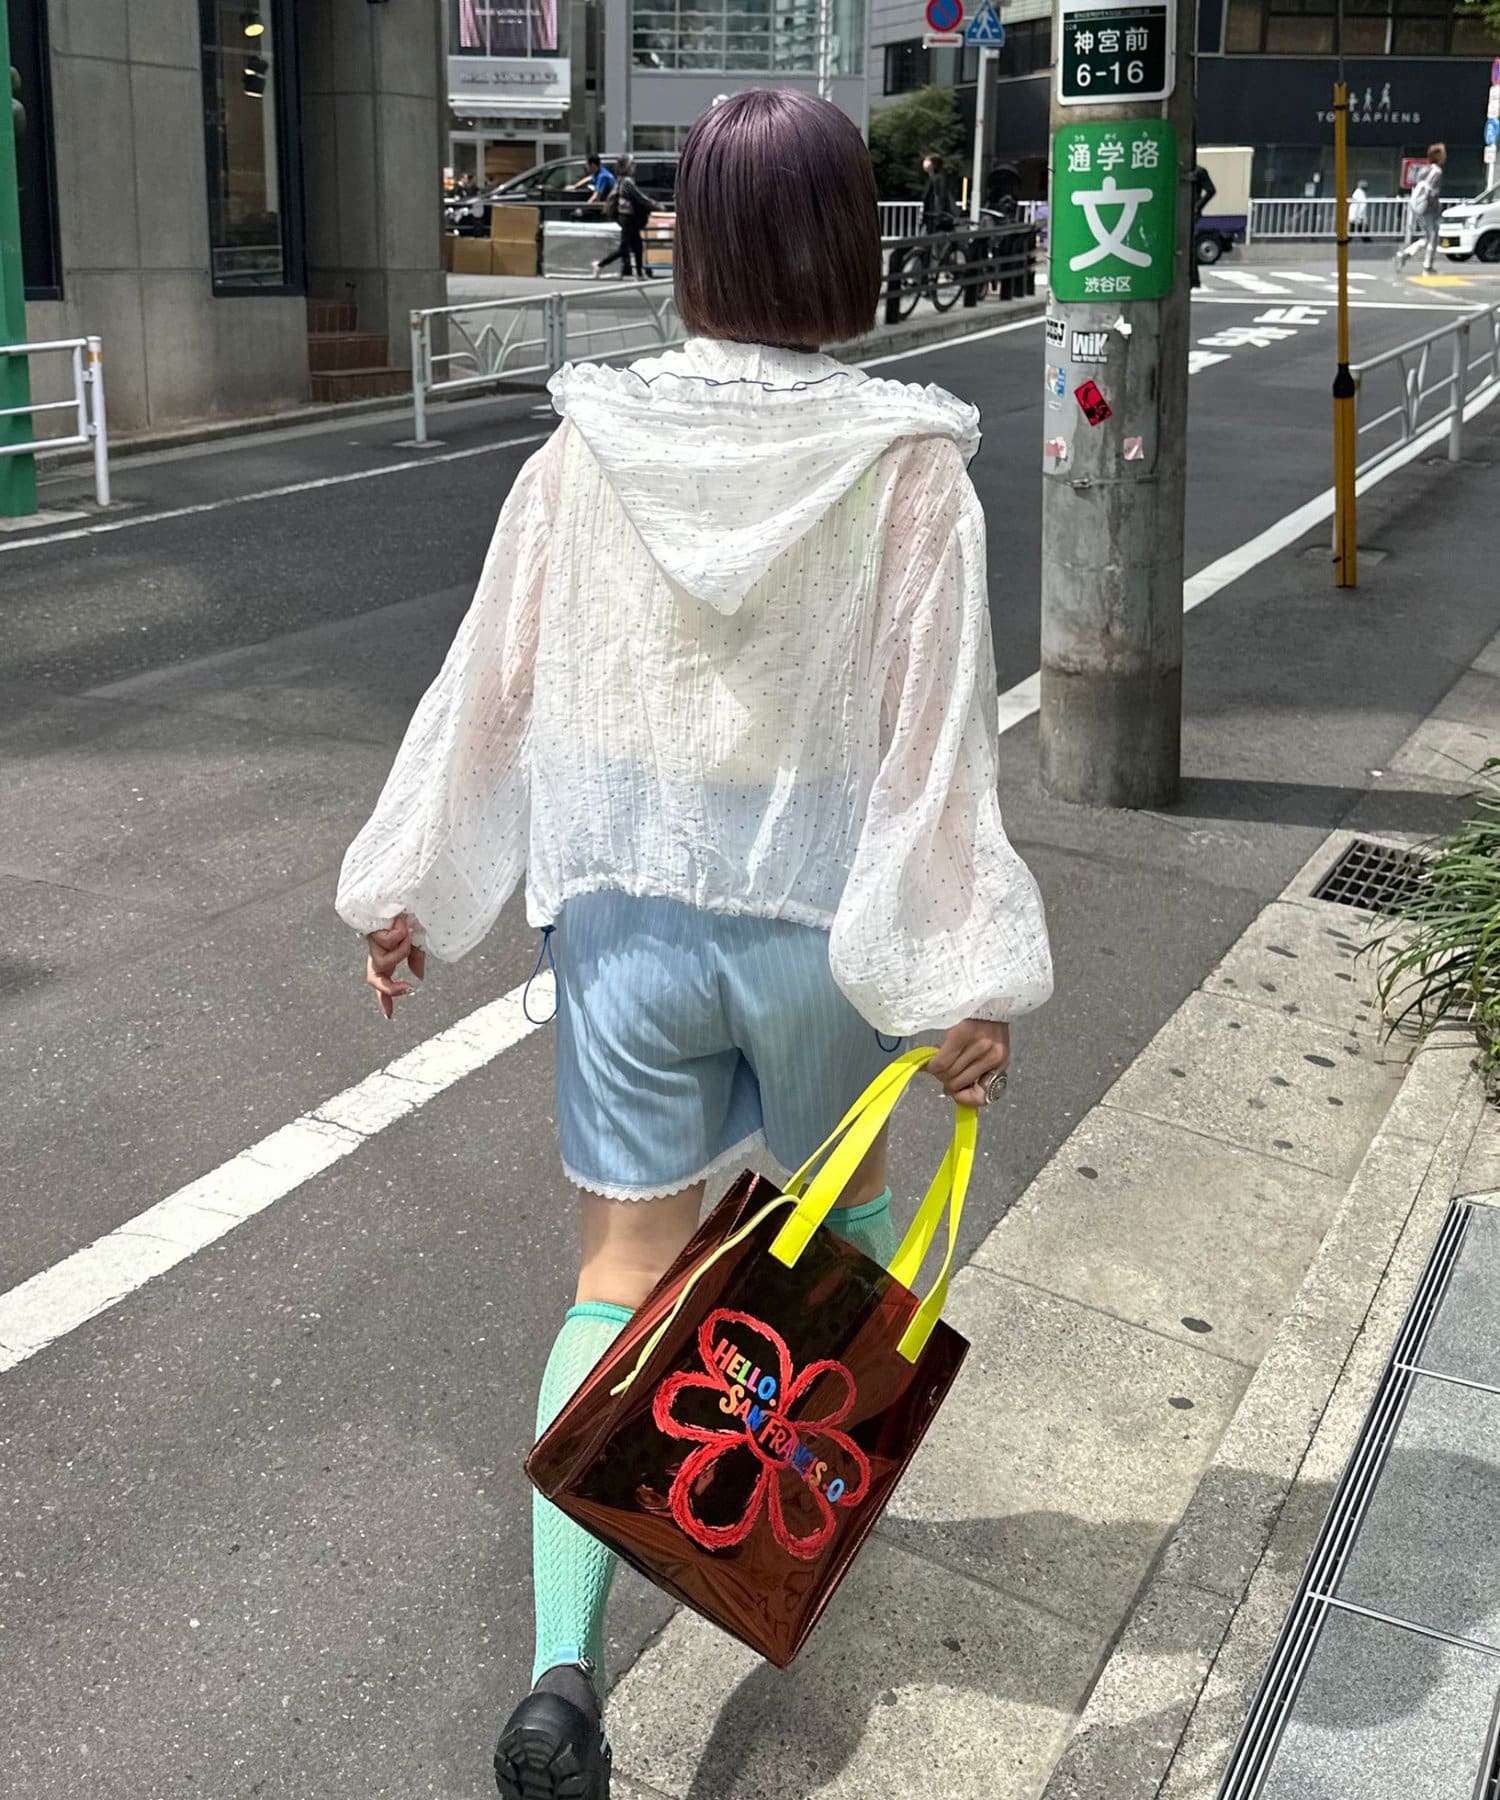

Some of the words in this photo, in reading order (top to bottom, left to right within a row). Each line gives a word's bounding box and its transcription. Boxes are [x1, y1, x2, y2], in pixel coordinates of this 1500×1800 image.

[1074, 26, 1149, 55] 神宮前
[1076, 60, 1144, 87] 6-16
[1316, 111, 1347, 123] TO
[1352, 111, 1421, 123] SAPIENS
[1067, 139, 1159, 173] 通学路
[1069, 176, 1153, 272] 文
[1084, 276, 1132, 293] 渋谷区
[713, 1338, 777, 1407] HELLO.
[719, 1384, 767, 1432] SAN
